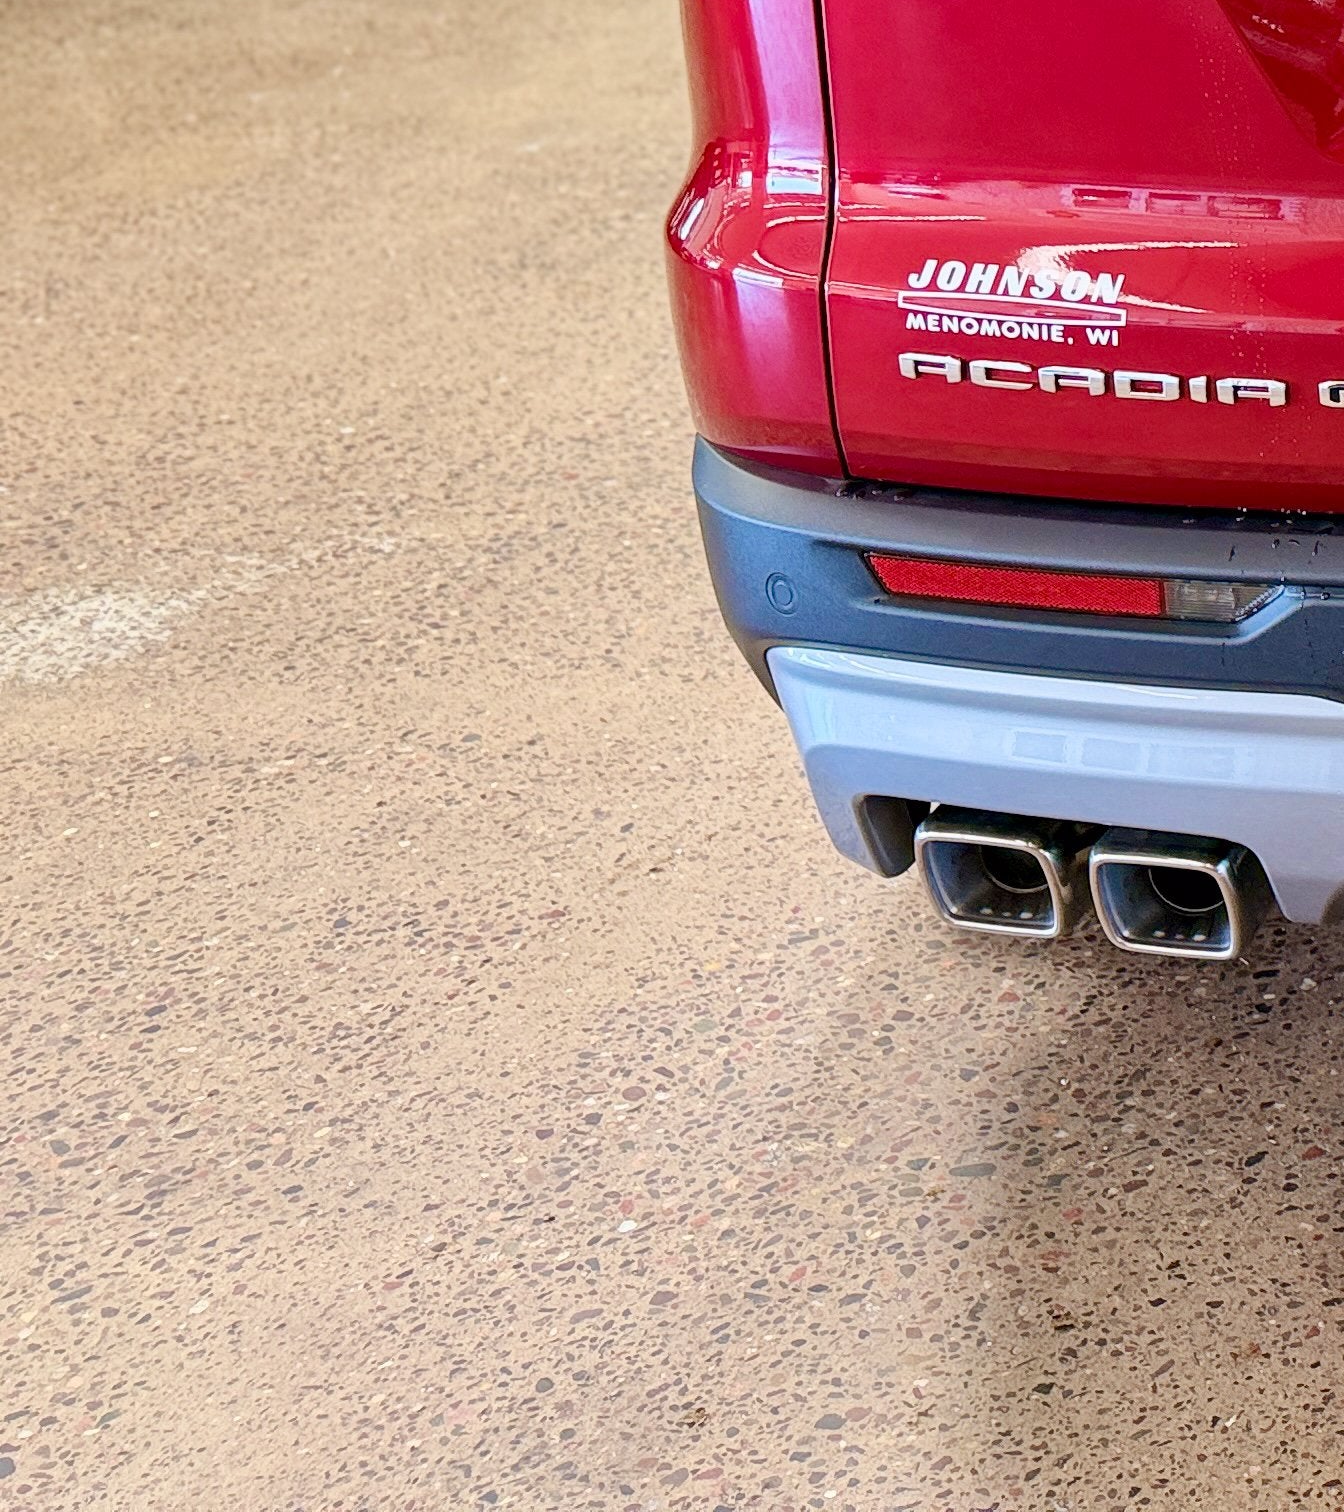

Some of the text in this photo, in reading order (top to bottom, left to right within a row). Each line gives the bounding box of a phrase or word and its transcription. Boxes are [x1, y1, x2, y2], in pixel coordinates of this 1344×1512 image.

[907, 259, 1125, 304] JOHNSON
[1086, 327, 1119, 346] WI
[899, 352, 1287, 407] ACADIA
